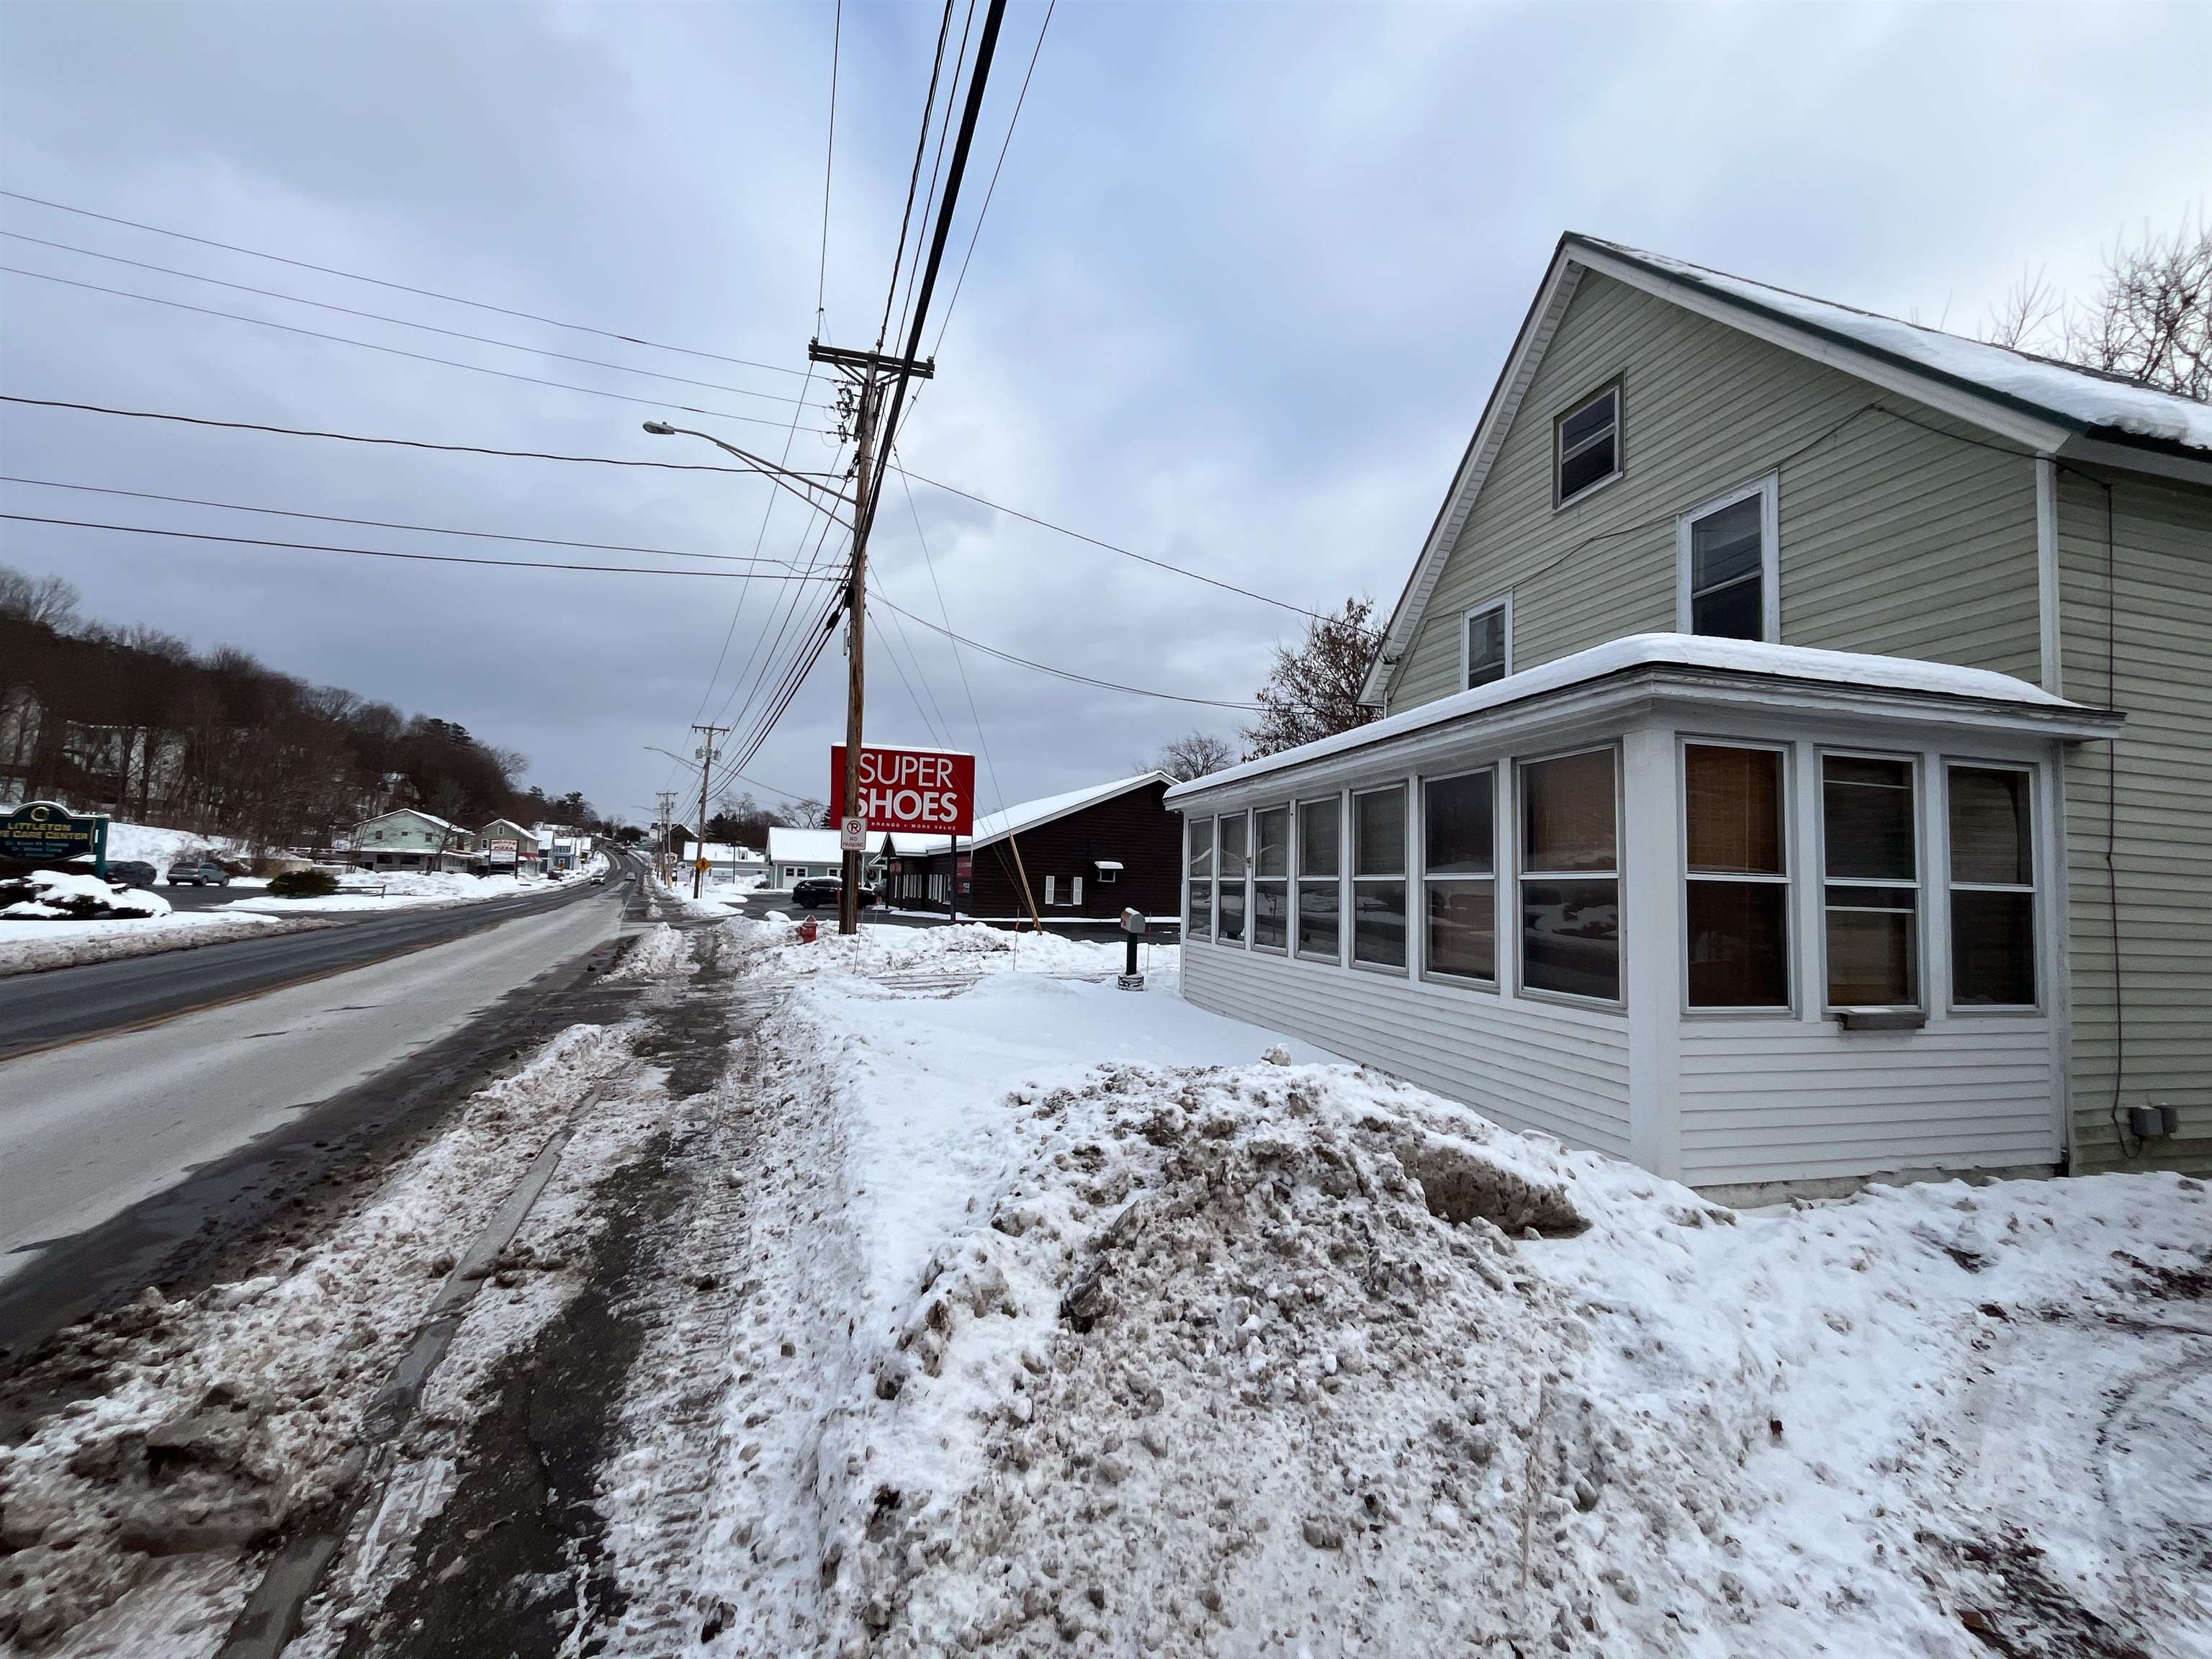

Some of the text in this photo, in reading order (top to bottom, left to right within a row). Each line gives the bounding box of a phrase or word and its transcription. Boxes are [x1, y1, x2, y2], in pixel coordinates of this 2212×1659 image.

[859, 753, 953, 788] SUPER
[858, 787, 958, 822] SHOES
[7, 822, 71, 831] LITTLETON
[13, 830, 42, 839] CARE
